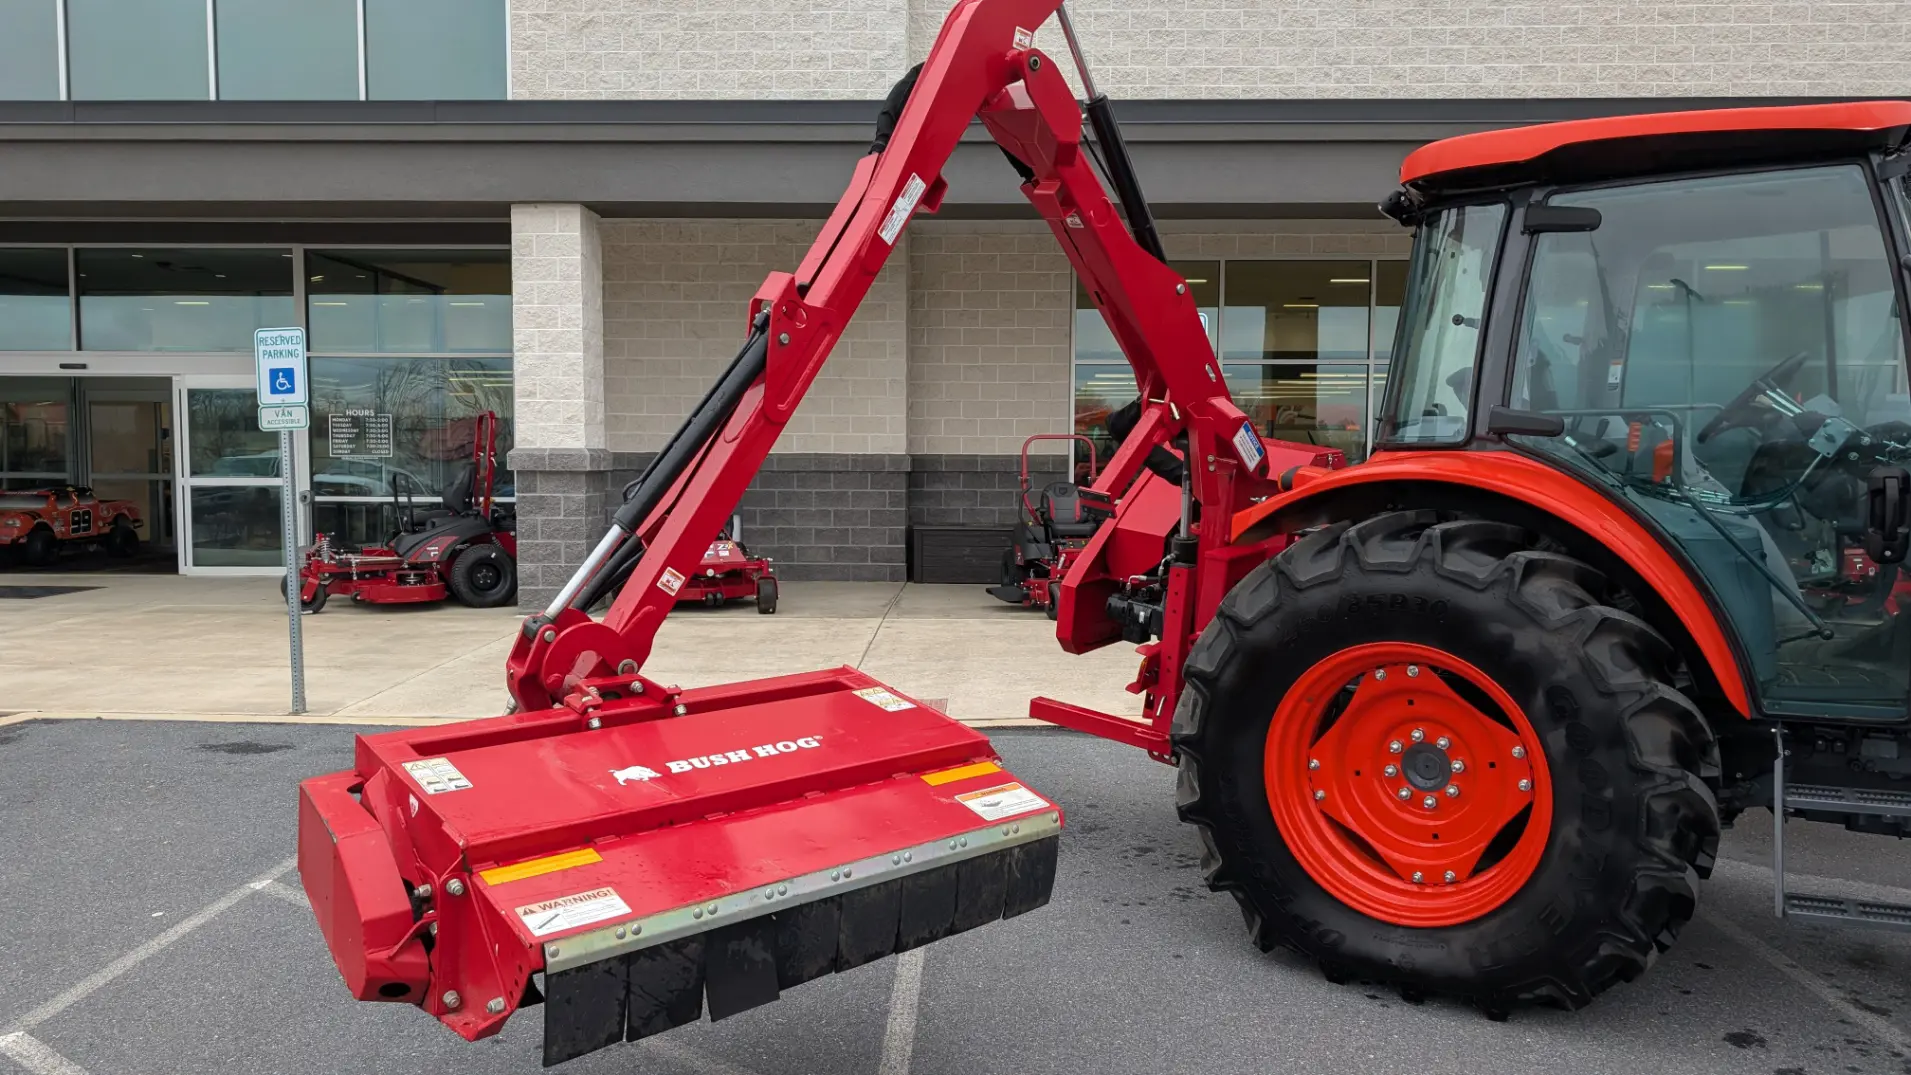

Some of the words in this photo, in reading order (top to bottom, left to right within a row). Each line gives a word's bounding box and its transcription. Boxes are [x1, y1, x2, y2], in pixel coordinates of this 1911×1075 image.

[260, 335, 302, 347] RESERVED
[262, 349, 300, 360] PARKING
[274, 410, 293, 418] VAN
[345, 409, 375, 417] HOURS
[70, 509, 92, 536] 99
[665, 749, 752, 774] BUSH
